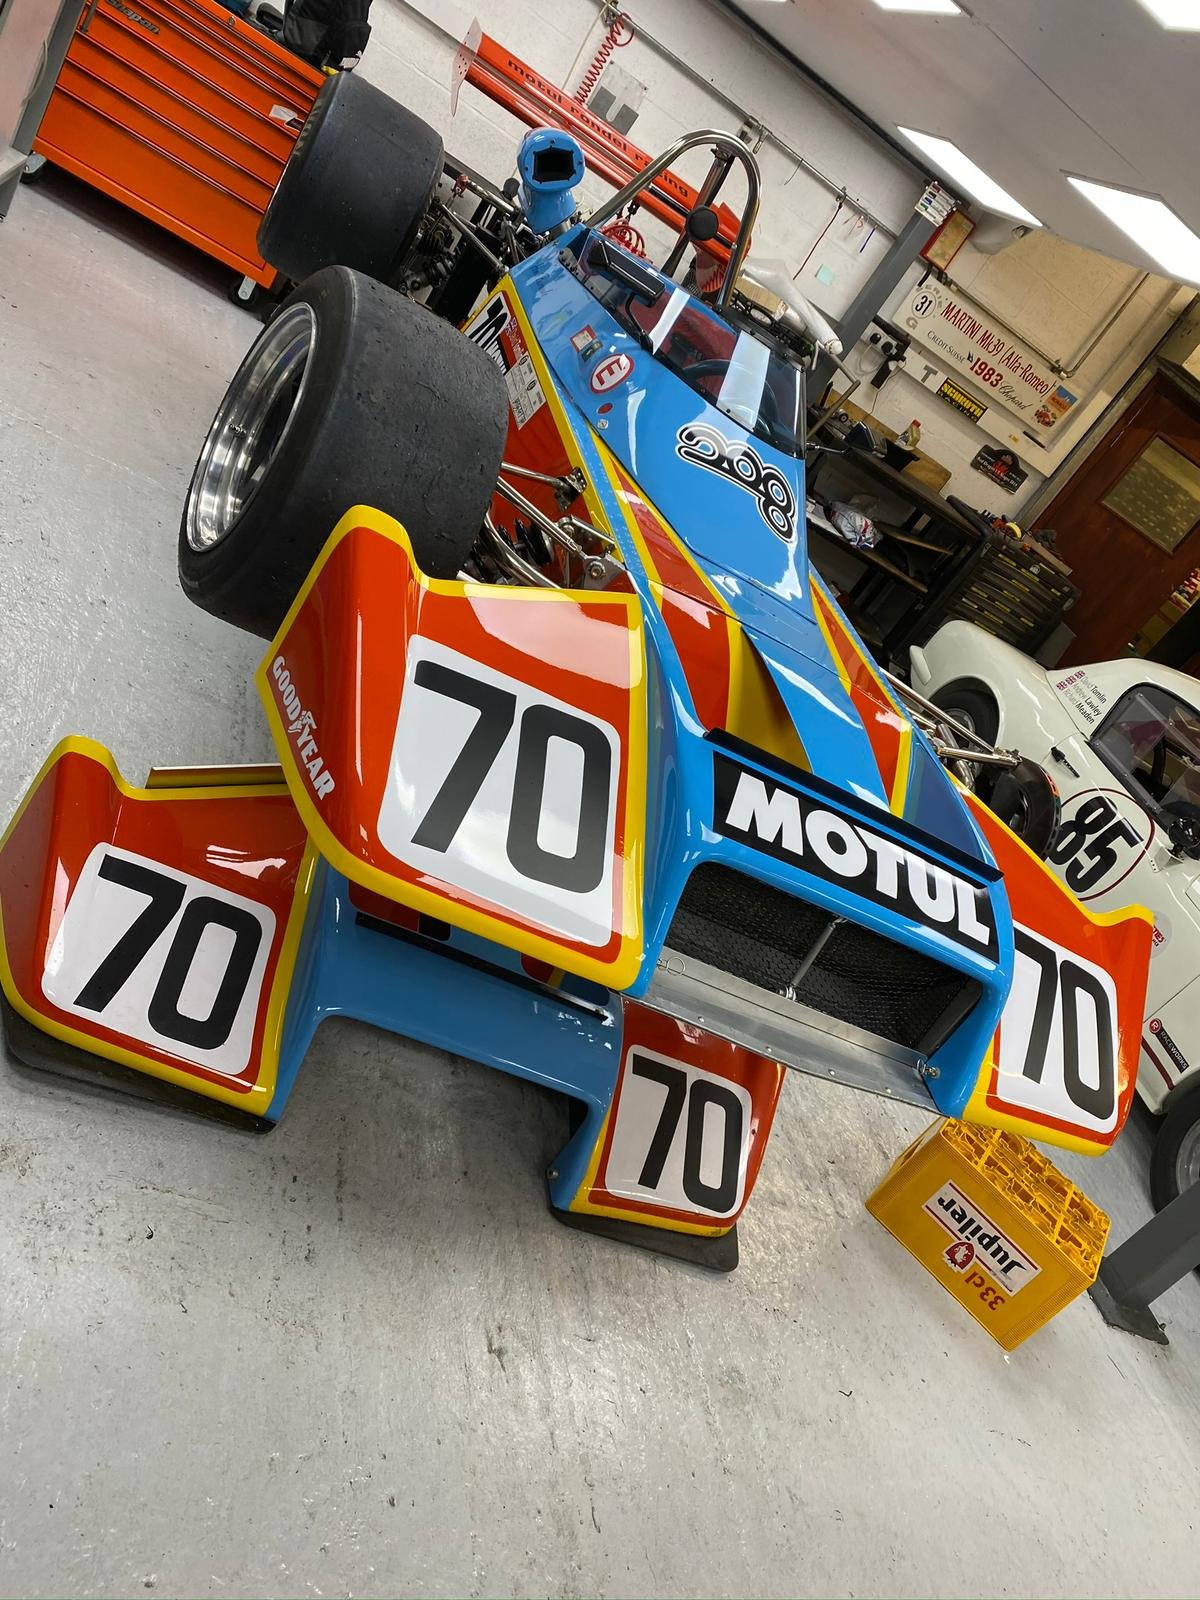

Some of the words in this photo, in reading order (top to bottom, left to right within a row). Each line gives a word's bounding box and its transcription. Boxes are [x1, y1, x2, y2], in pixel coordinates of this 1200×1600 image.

[507, 59, 562, 104] motul
[570, 106, 628, 152] rondel
[469, 296, 508, 350] 70
[915, 295, 933, 315] 31
[921, 364, 938, 383] T
[940, 301, 982, 340] MARTINI
[976, 330, 1005, 357] Mk39
[998, 345, 1057, 398] (Alfa-Romeo)
[969, 357, 1004, 388] 1983
[998, 381, 1033, 410] Chopard
[273, 655, 335, 800] GOODYEAR
[1075, 702, 1095, 724] Meaden
[1085, 697, 1101, 717] Lawley
[1091, 685, 1107, 704] Tomlin
[411, 660, 612, 893] 70
[725, 772, 990, 946] MOTUL
[1048, 796, 1144, 893] 85
[73, 854, 262, 1050] 70
[1014, 928, 1115, 1120] 70
[1160, 1031, 1188, 1069] RACEWORKS
[632, 1053, 743, 1213] 70
[938, 1197, 1026, 1275] Jupiler
